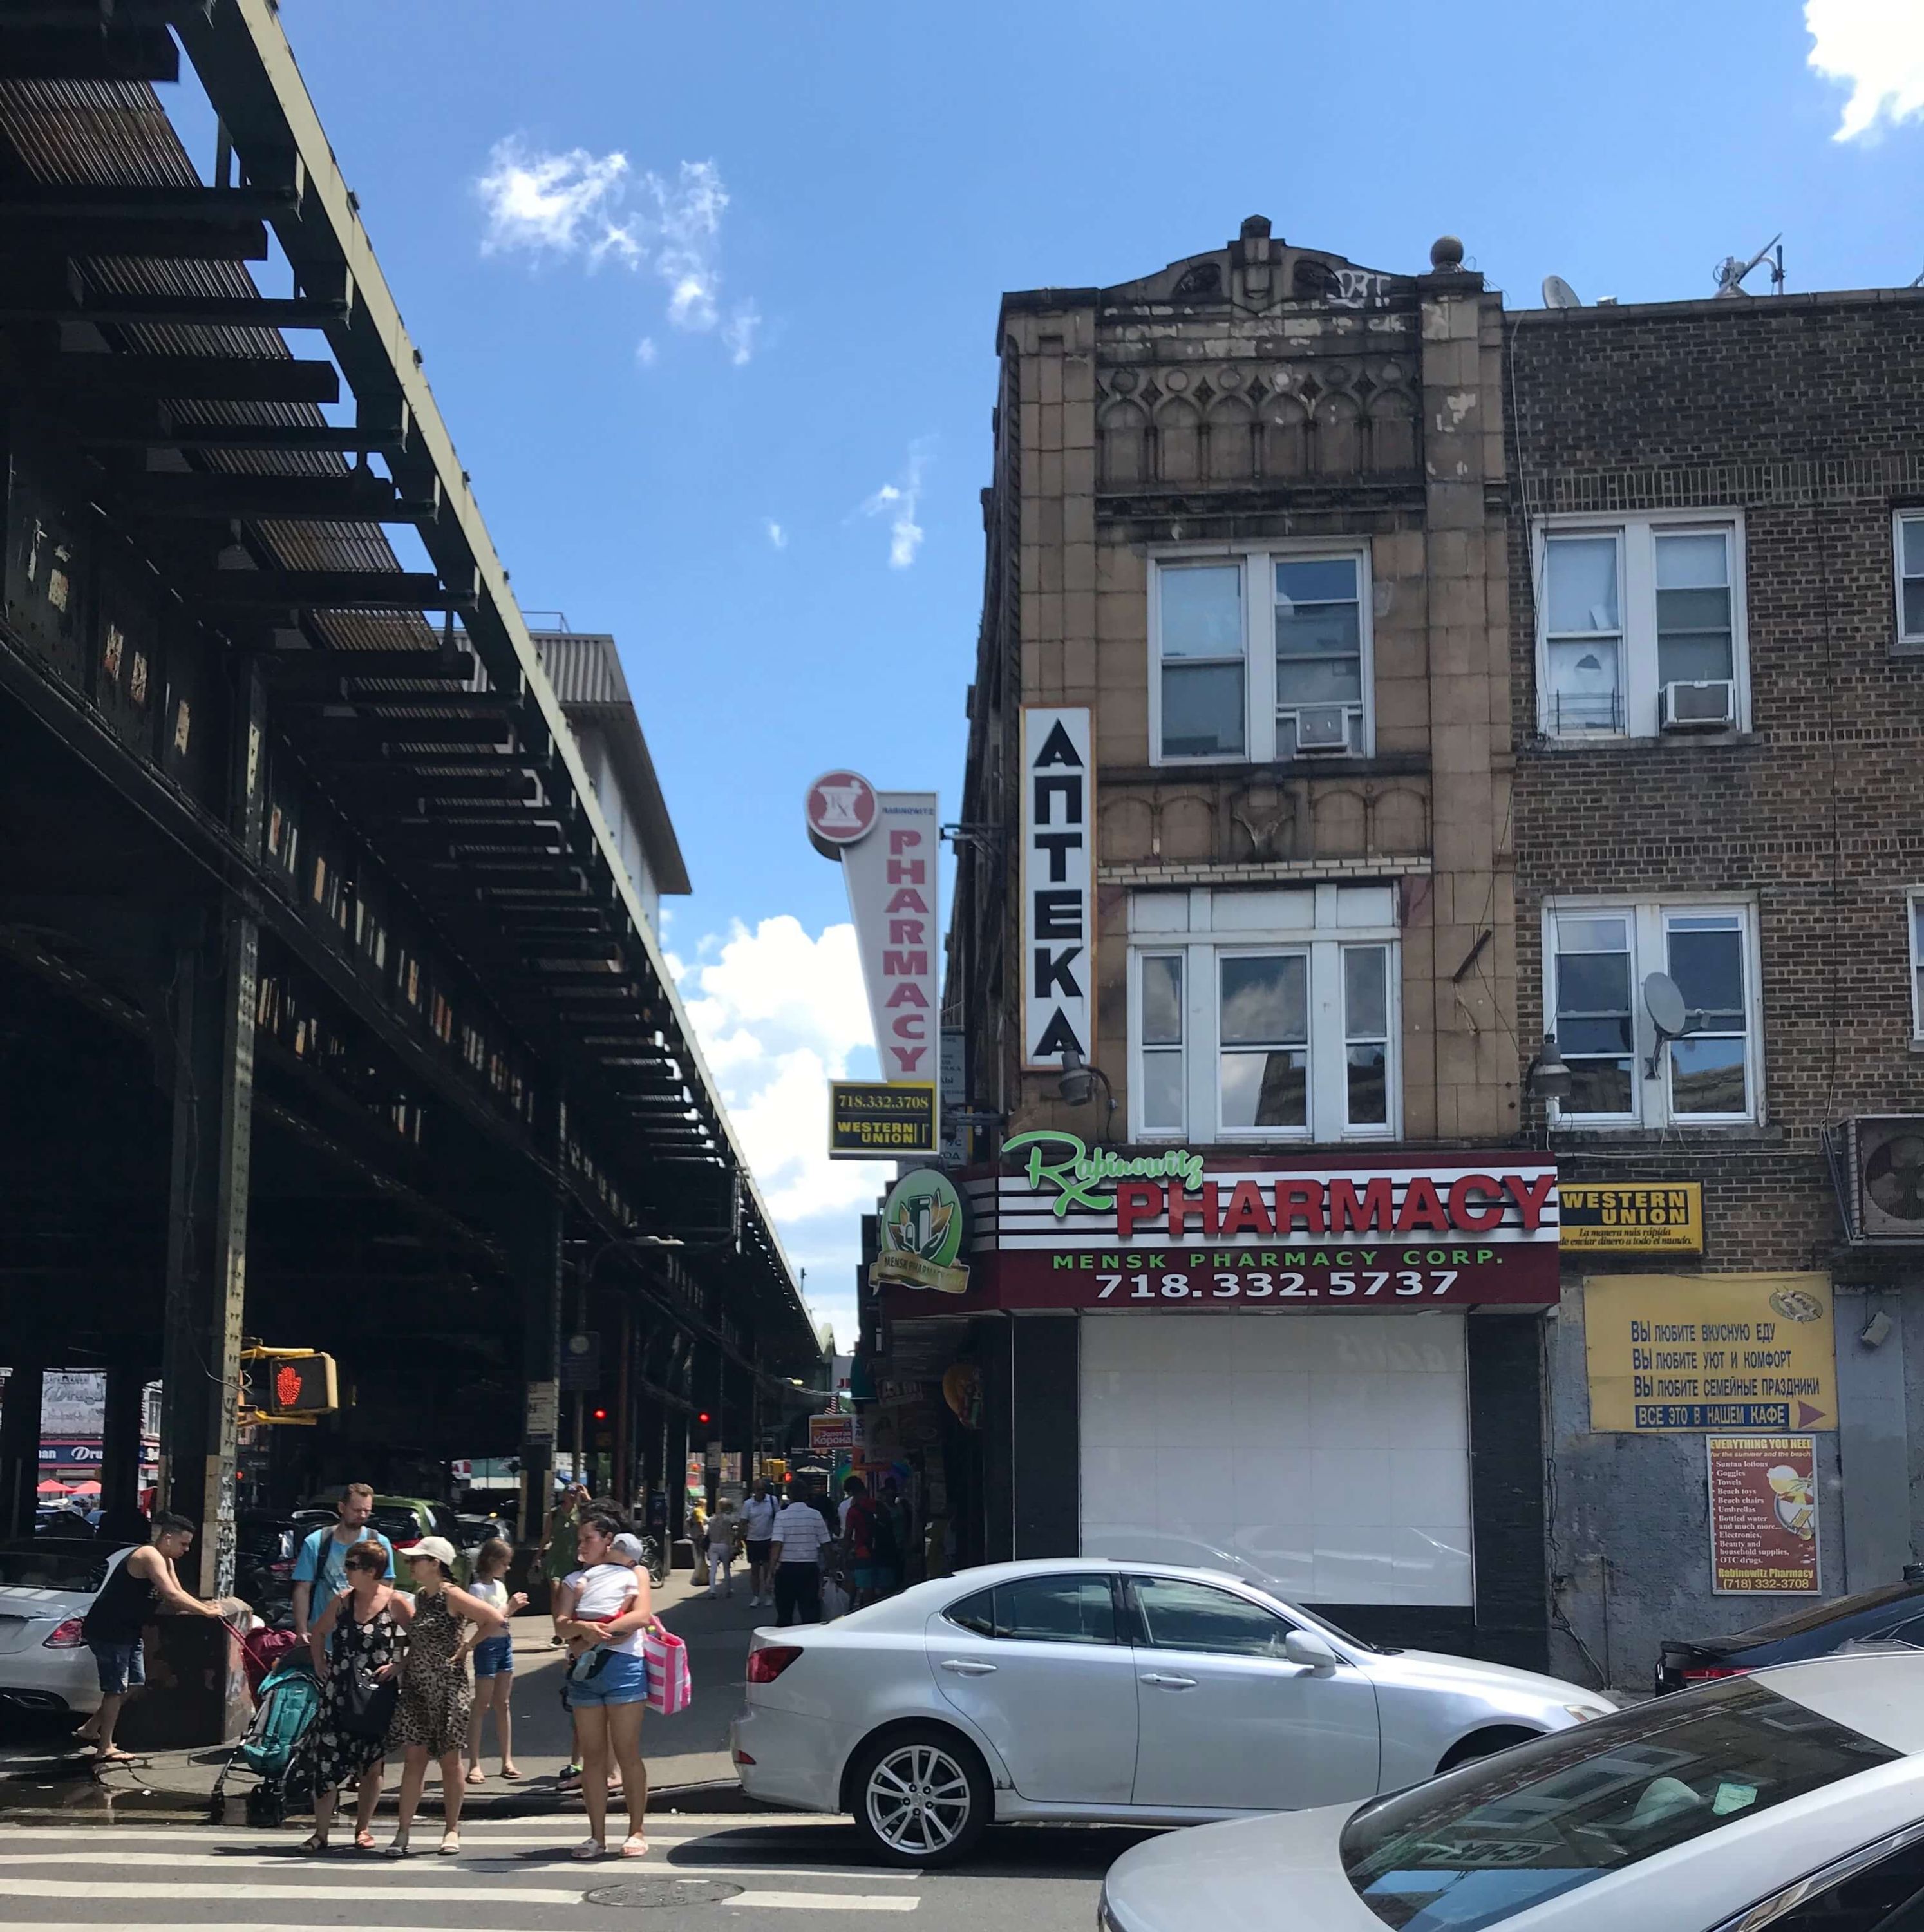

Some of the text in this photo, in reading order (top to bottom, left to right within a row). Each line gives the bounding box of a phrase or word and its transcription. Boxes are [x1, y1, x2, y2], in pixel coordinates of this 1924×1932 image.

[1032, 717, 1086, 1056] АПТЕКА
[883, 829, 929, 1072] PHARMACY
[838, 1095, 928, 1108] 718.332.3708
[838, 1122, 913, 1133] WESTERN
[862, 1133, 913, 1143] UNION
[1117, 1174, 1556, 1236] PHARMACY
[1562, 1191, 1685, 1208] WESTERN
[1602, 1208, 1686, 1224] UNION
[1570, 1236, 1596, 1246] enviar
[1598, 1236, 1625, 1245] dinero
[1633, 1236, 1650, 1245] todo
[1653, 1236, 1661, 1245] el
[1579, 1228, 1590, 1236] La
[1643, 1227, 1671, 1239] rápida
[1053, 1249, 1503, 1269] MENSK PHARMACY CORP.
[1095, 1271, 1458, 1298] 718.332.5737
[1631, 1321, 1775, 1343] ВЫ ЛЮБИТЕ ВКУСНУЮ ЕДУ
[1633, 1348, 1791, 1370] ВЫ ЛЮБИТЕ УЮТ И КОМФОРТ
[1634, 1376, 1820, 1398] ВЫ ЛЮБИТЕ СЕМЕЙНЫЕ ПРАЗДНИКИ
[1639, 1405, 1786, 1425] ВСЕ ЭТО В НАШЕМ КАФЕ
[813, 1436, 851, 1446] Корона
[1711, 1439, 1768, 1449] EVERYTHING
[1769, 1439, 1788, 1449] YOU
[1740, 1557, 1763, 1565] drugs.
[1719, 1568, 1813, 1578] Rabinowitz Pharmacy
[1723, 1578, 1809, 1589] (718) 332-3708
